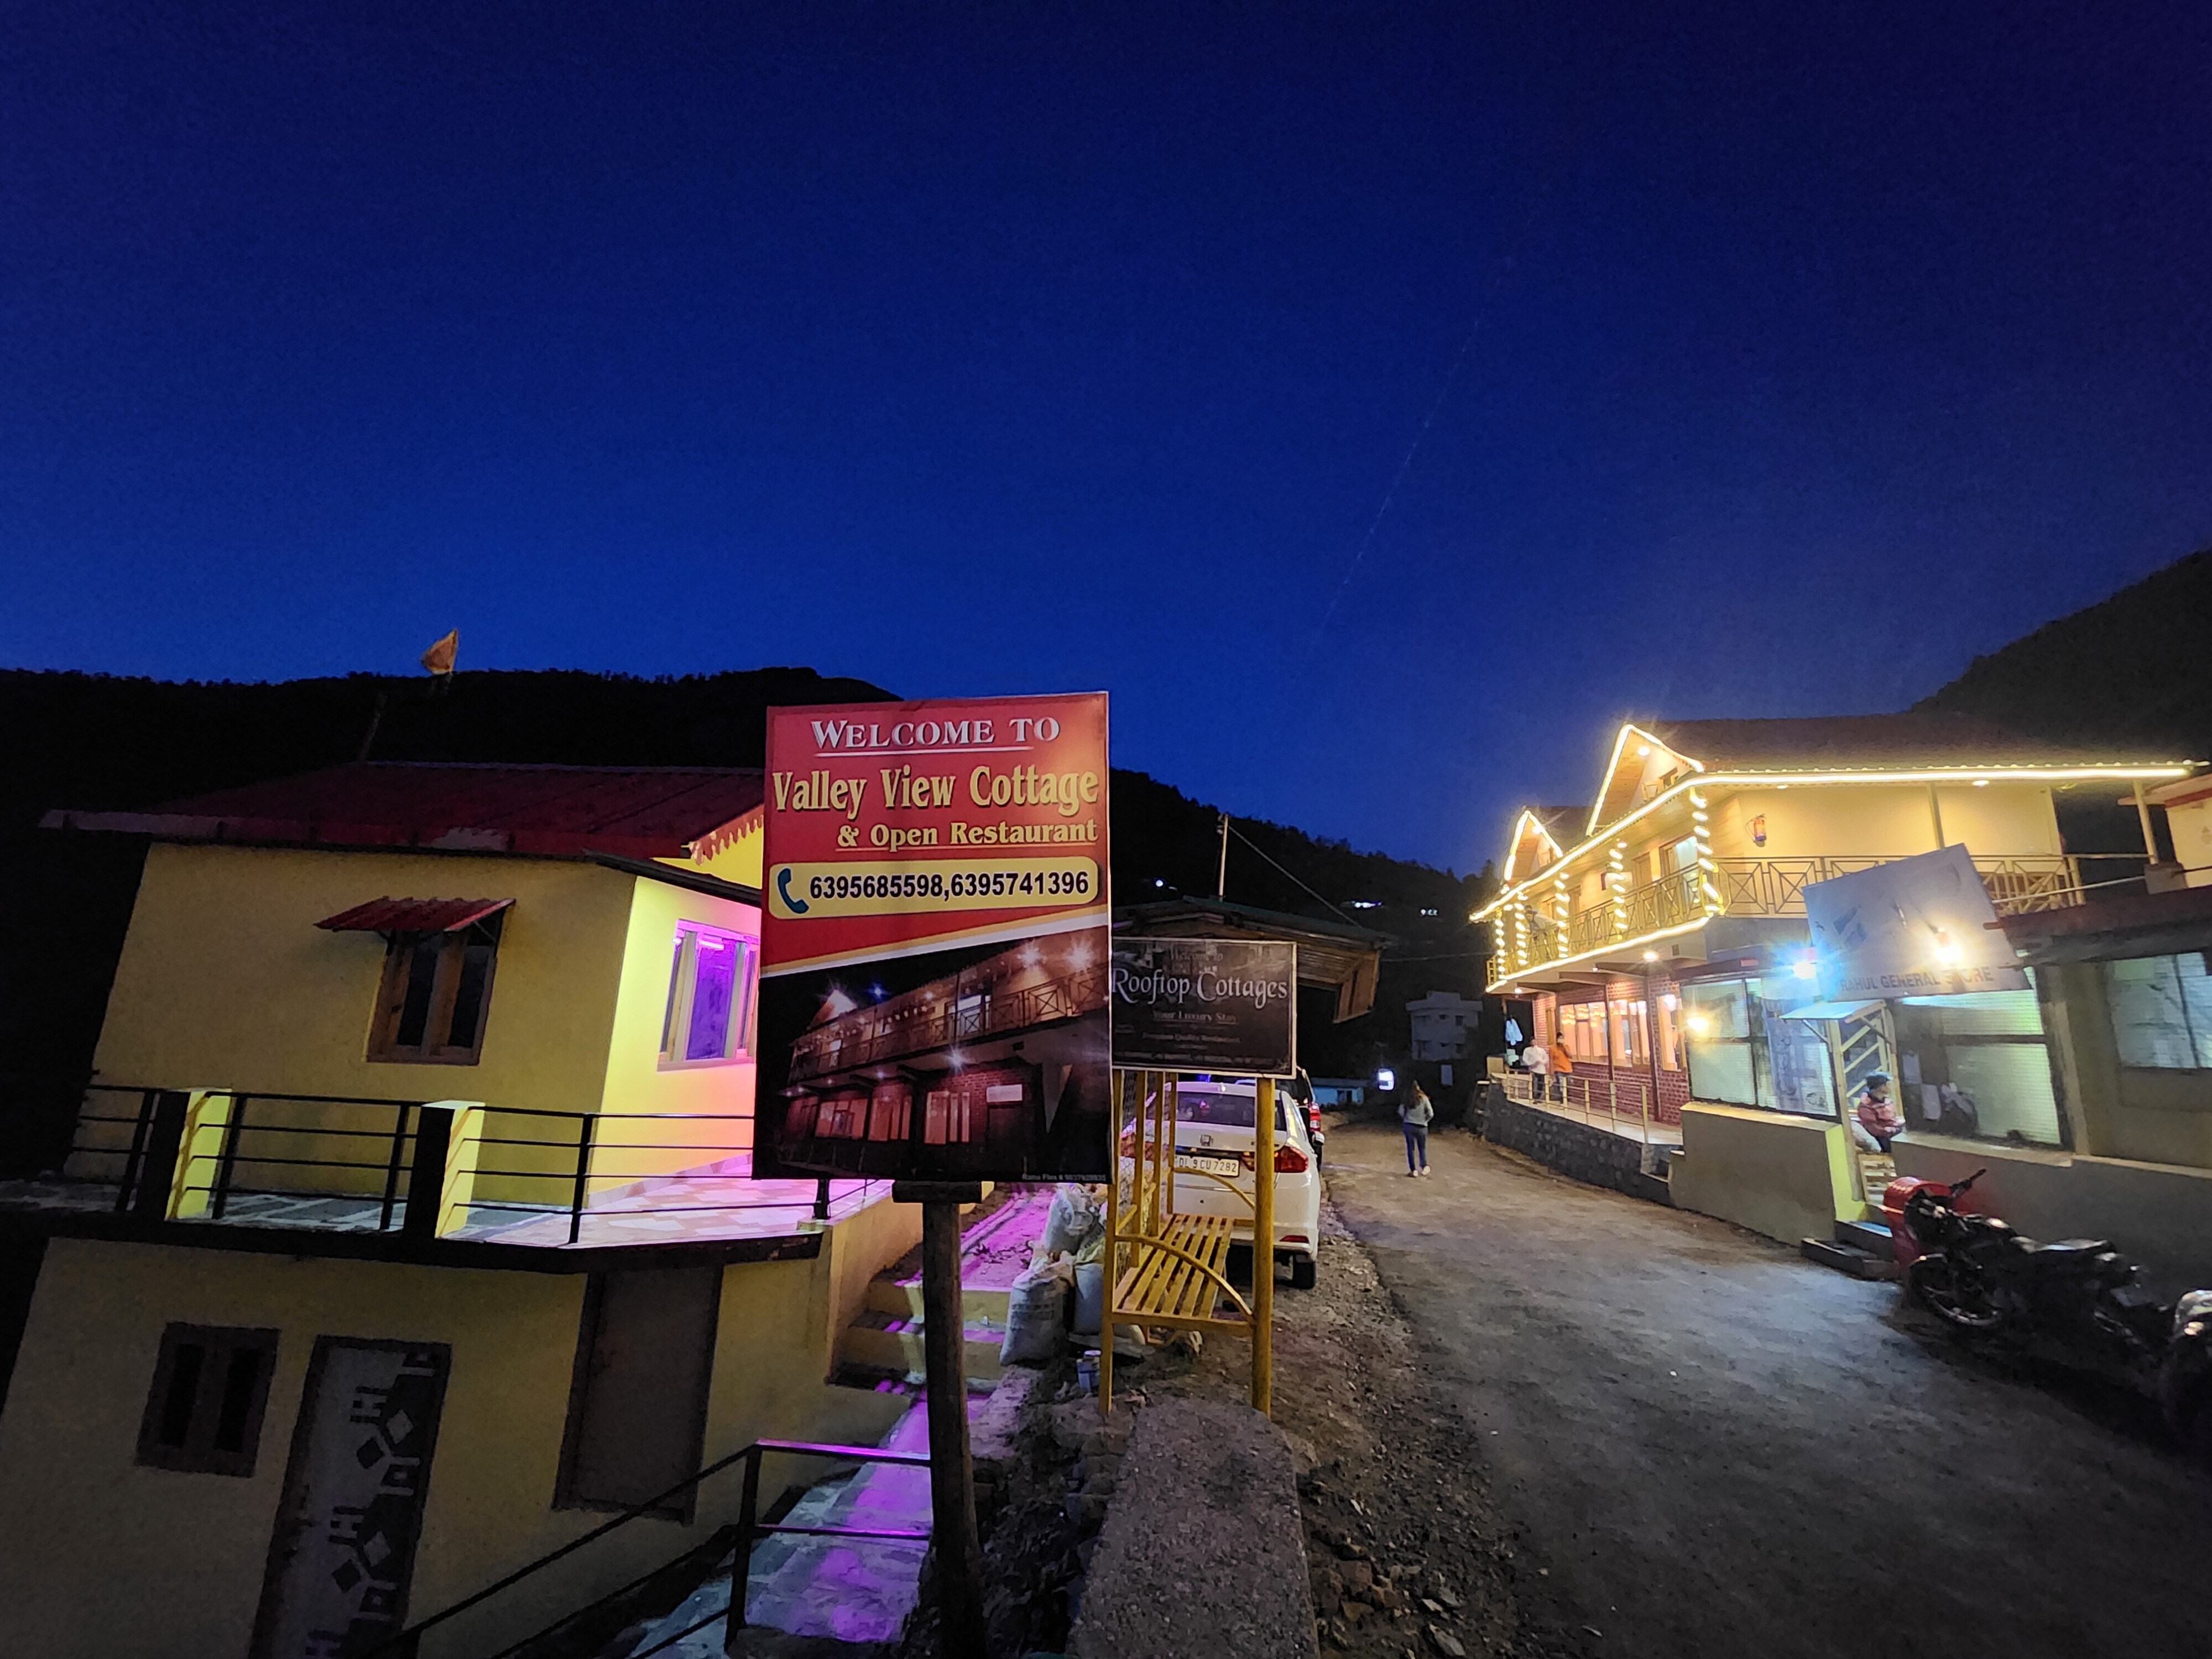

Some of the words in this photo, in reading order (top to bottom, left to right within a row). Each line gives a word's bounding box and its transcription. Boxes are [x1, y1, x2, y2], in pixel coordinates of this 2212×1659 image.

[811, 719, 995, 749] WELCOME
[1009, 716, 1060, 742] TO
[773, 769, 867, 820] Valley
[880, 764, 956, 807] View
[969, 764, 1099, 816] Cottage
[837, 824, 859, 847] &
[870, 824, 938, 852] Open
[950, 818, 1099, 845] Restaurant
[1112, 967, 1191, 1005] Rooftop
[1197, 971, 1288, 1009] Cottages
[1840, 975, 1879, 992] RAHUL
[1880, 972, 1941, 989] GENERAL
[1214, 1161, 1237, 1173] 7282
